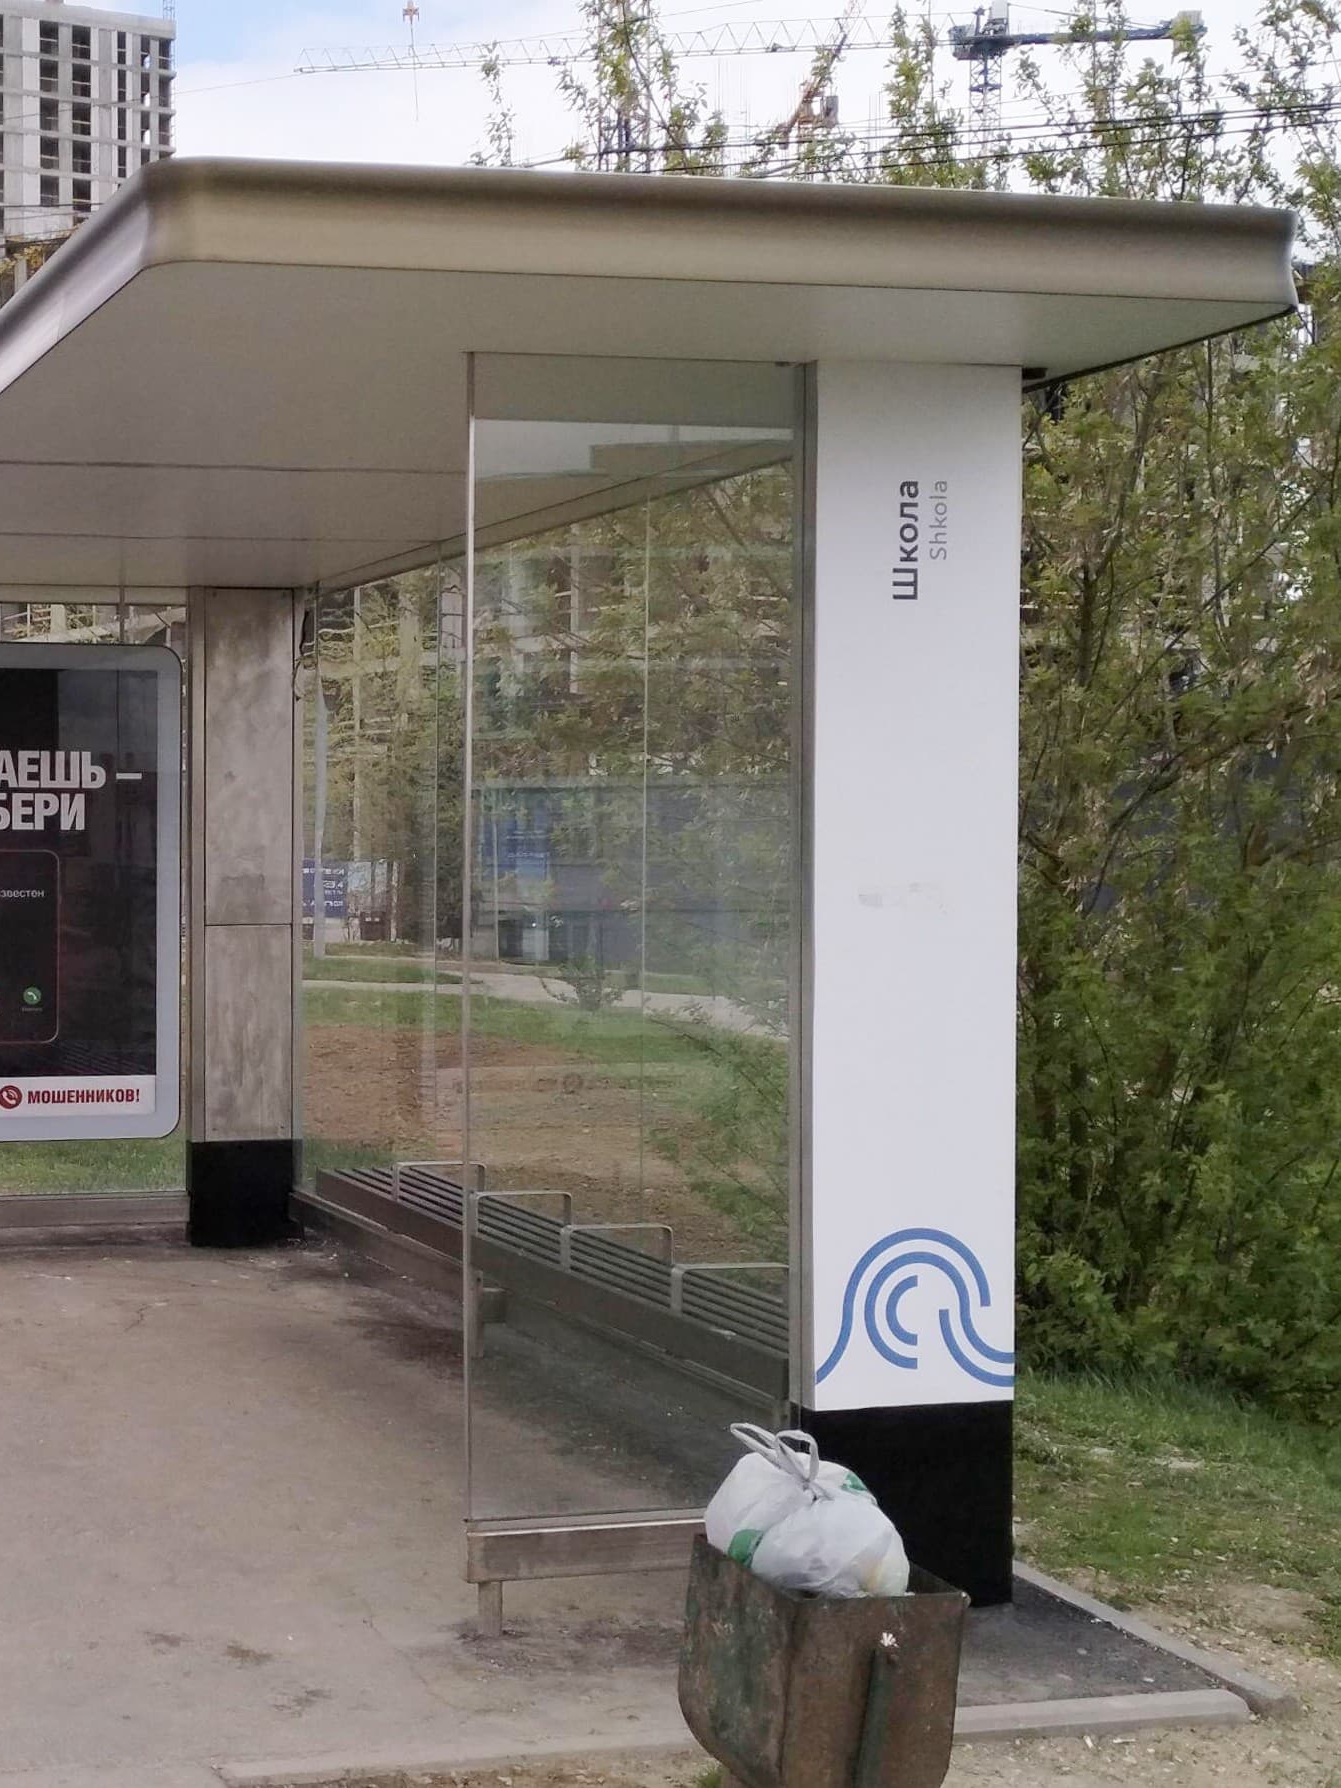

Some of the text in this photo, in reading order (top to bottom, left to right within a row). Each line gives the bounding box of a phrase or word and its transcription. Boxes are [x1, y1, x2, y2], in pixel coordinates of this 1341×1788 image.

[892, 480, 919, 601] Школа
[928, 480, 948, 561] Shkola
[27, 1087, 141, 1105] МОШЕННИКОВ!
